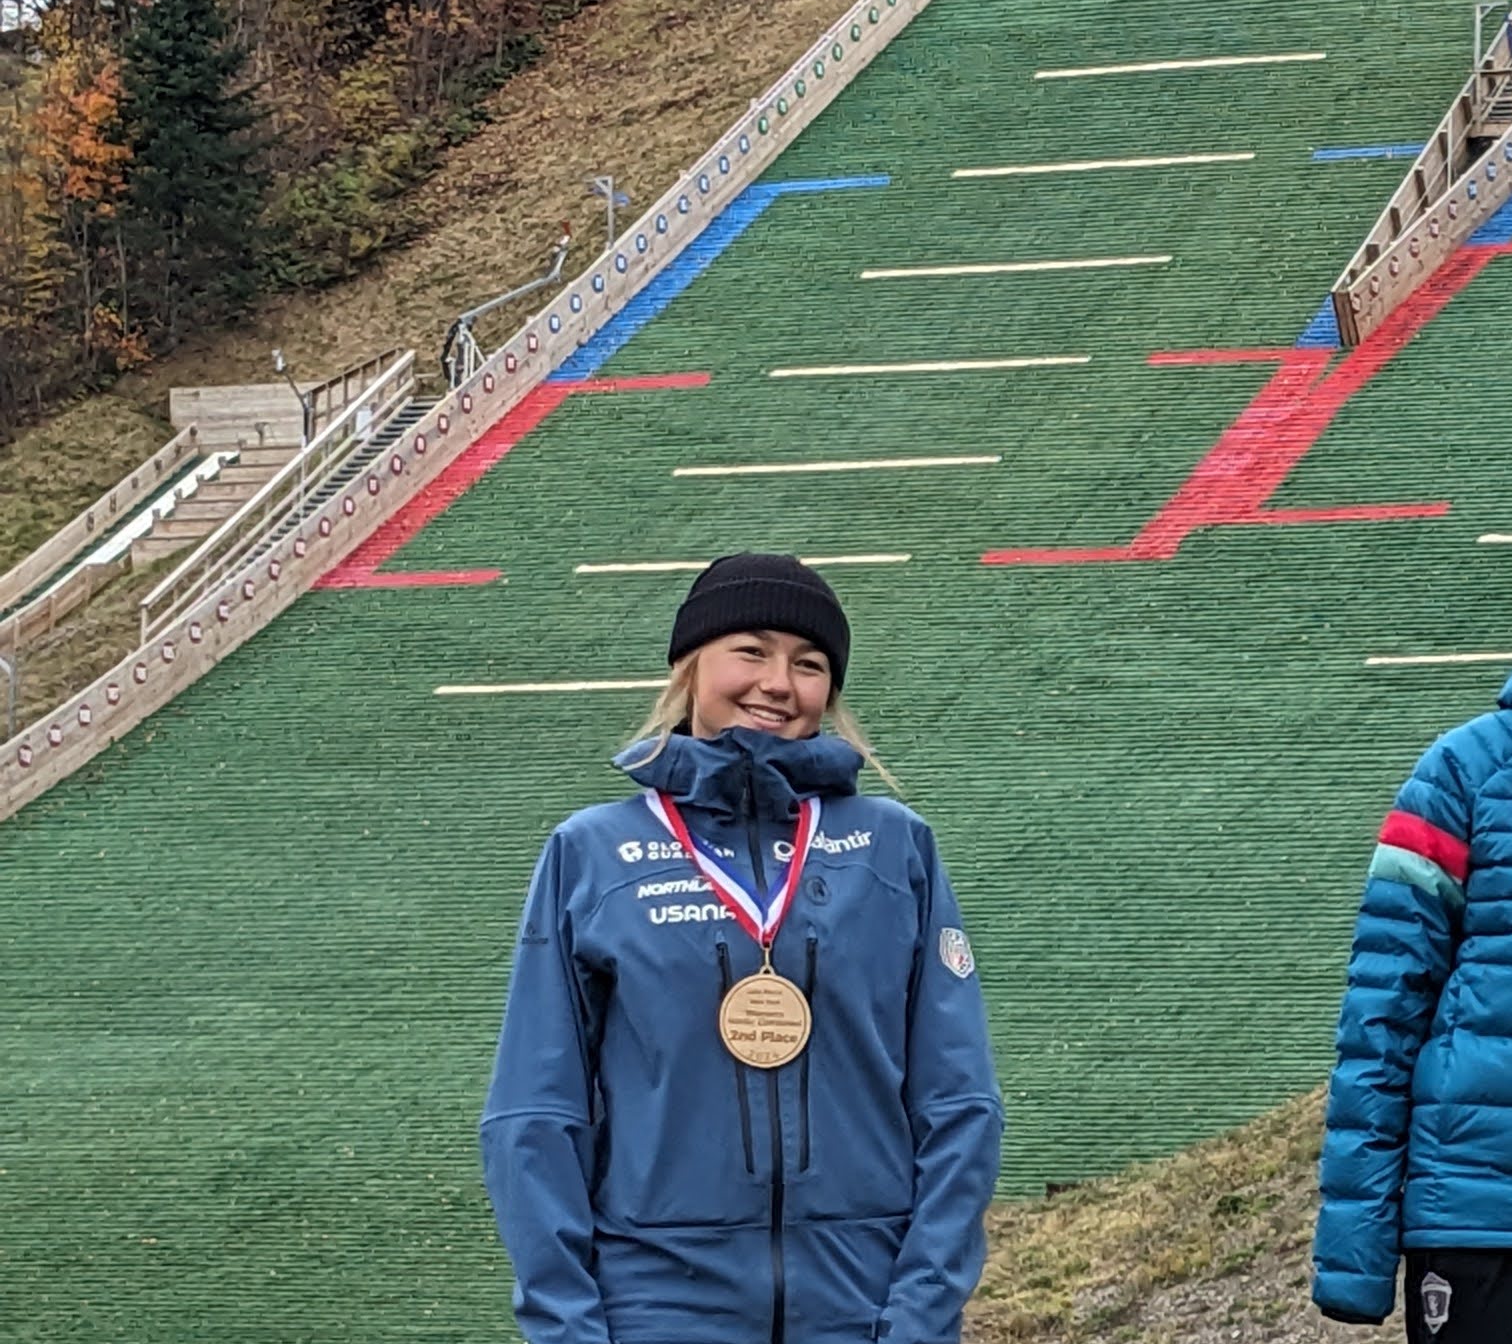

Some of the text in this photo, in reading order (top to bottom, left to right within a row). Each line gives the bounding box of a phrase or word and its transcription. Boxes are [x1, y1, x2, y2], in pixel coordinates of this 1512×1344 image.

[811, 830, 873, 855] alantir
[729, 1029, 798, 1044] 2nd Place
